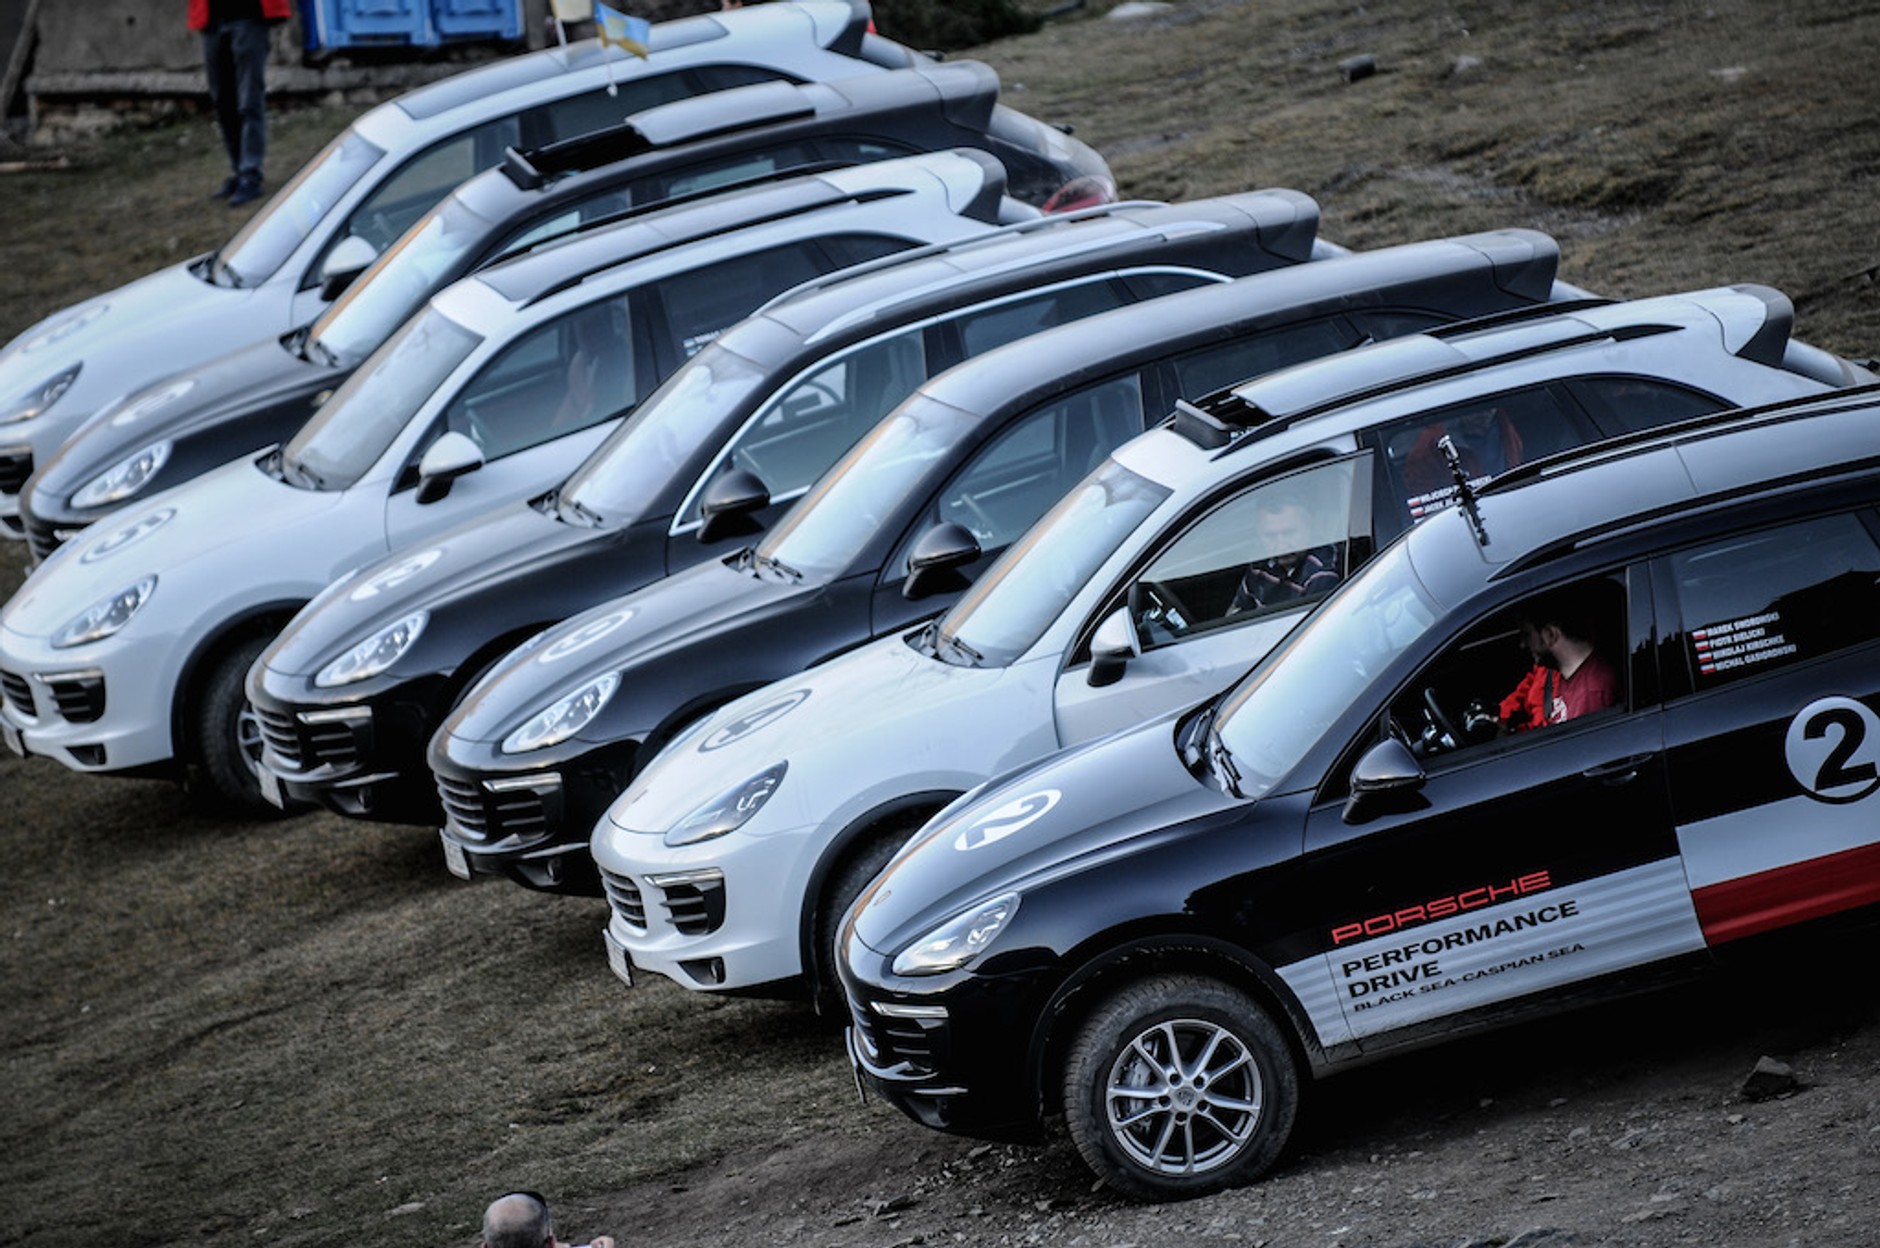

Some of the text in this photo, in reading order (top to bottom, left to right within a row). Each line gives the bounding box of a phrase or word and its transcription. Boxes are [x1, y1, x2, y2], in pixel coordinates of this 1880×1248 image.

[1709, 635, 1732, 648] PIOTR
[718, 699, 796, 743] 4
[1804, 708, 1877, 792] 2
[966, 794, 1049, 848] 2
[1331, 870, 1551, 944] PORSCHE
[1342, 900, 1580, 977] PERFORMANCE
[1348, 960, 1442, 998] DRIVE
[1354, 988, 1416, 1012] BLACK
[1547, 943, 1585, 959] SEA
